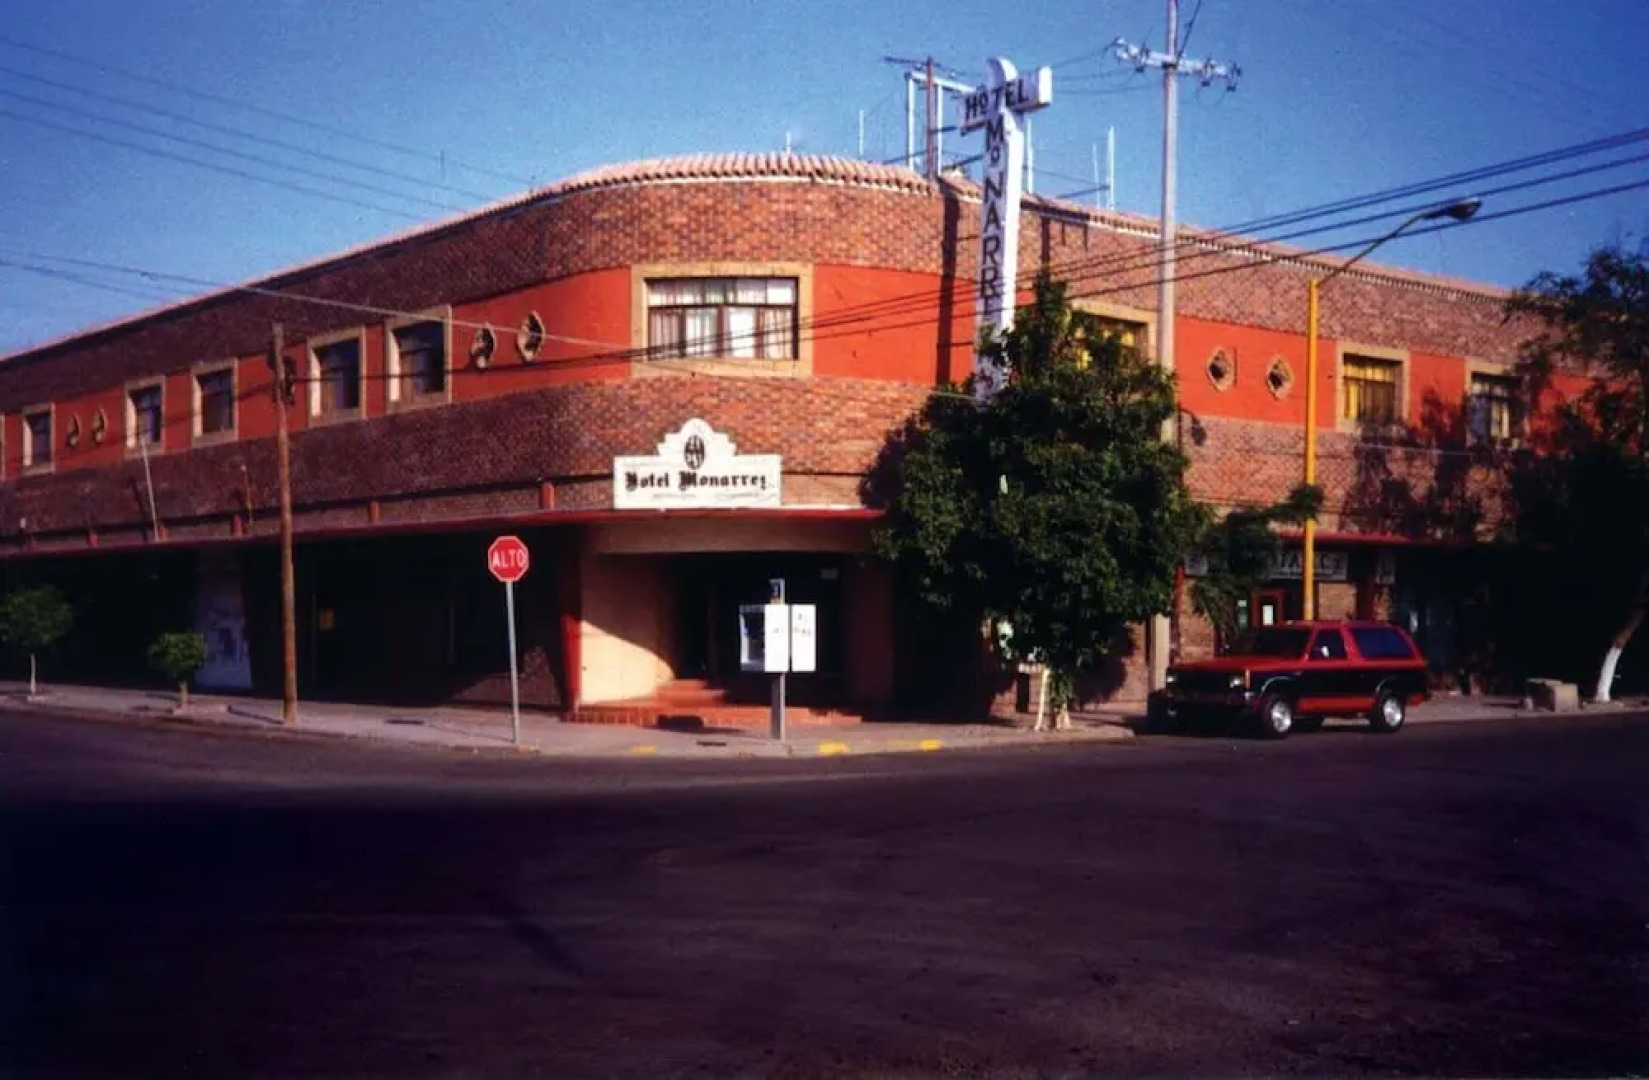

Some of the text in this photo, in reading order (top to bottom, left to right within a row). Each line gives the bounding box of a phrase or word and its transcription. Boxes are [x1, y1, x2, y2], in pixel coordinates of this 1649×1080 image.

[625, 470, 767, 492] Hotel Monarrez
[491, 548, 526, 568] ALTO
